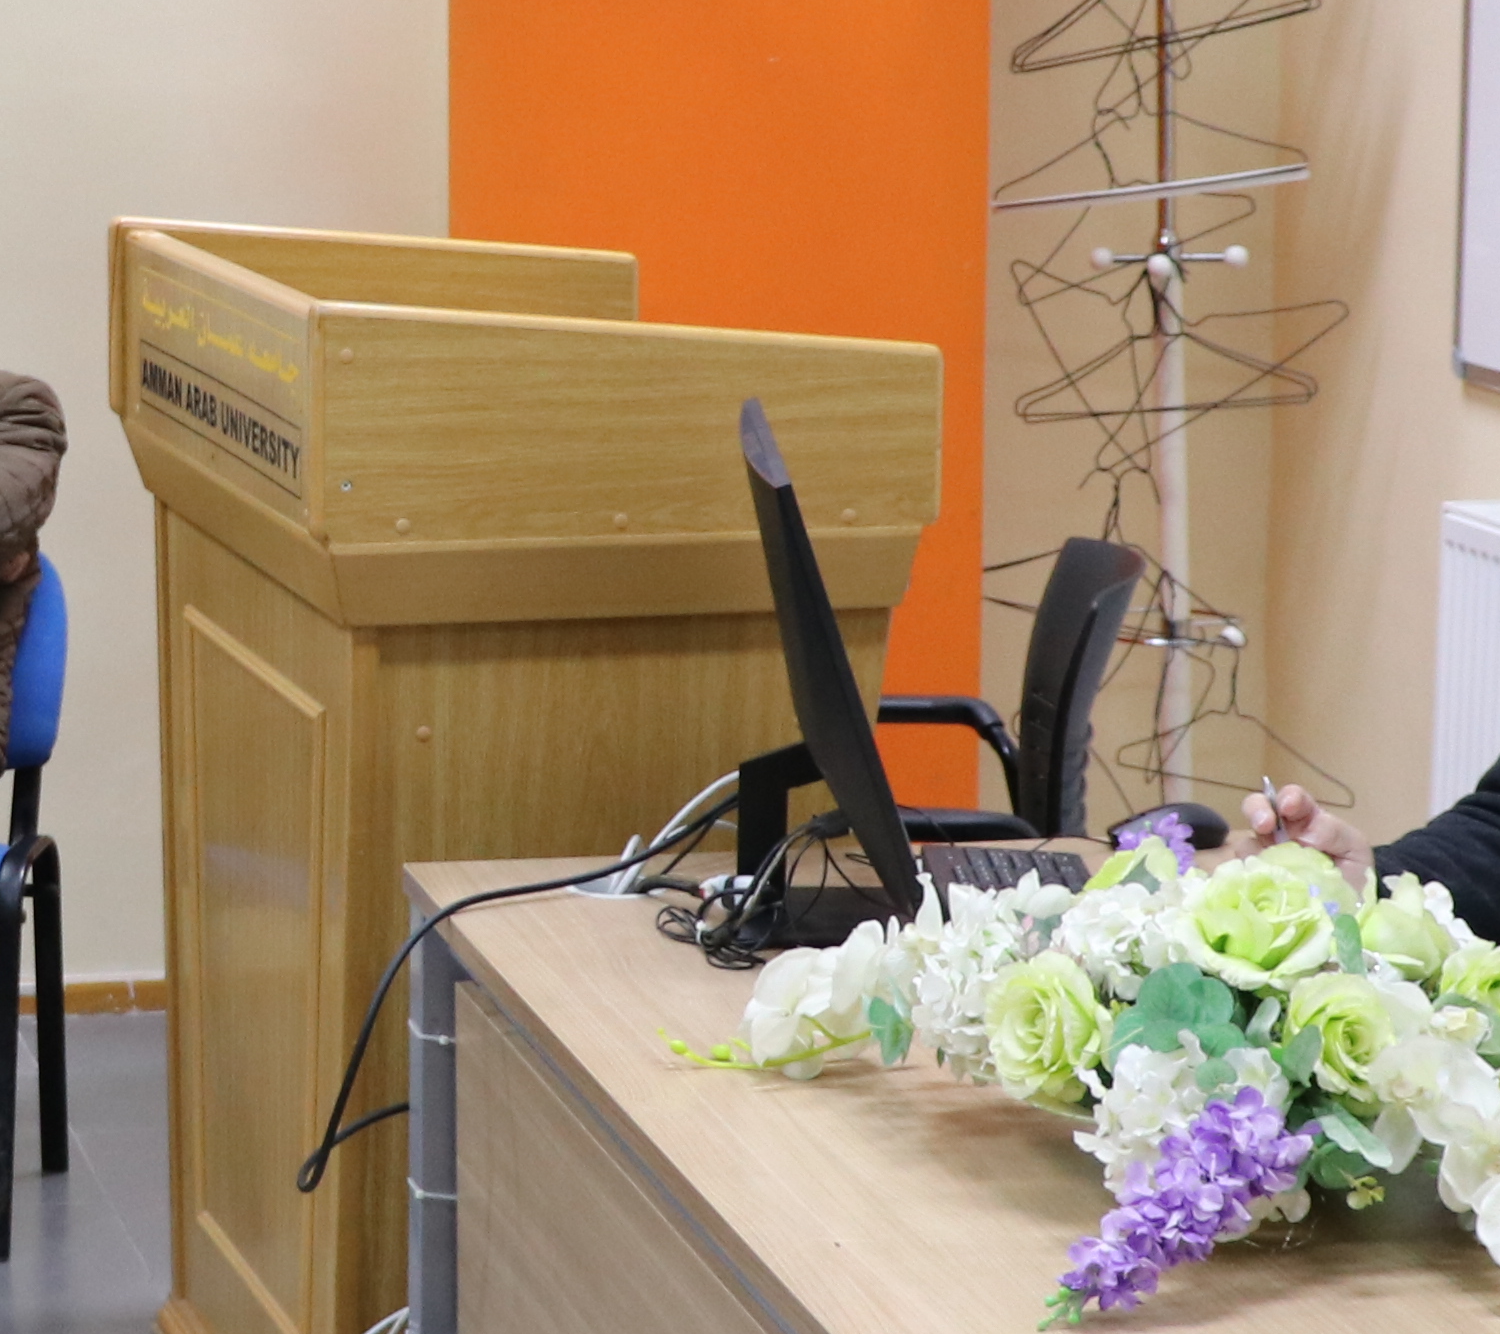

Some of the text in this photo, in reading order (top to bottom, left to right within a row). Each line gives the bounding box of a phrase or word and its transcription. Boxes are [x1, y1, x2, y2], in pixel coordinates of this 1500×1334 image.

[142, 358, 300, 479] AMMAN ARAB UNIVERSITY
